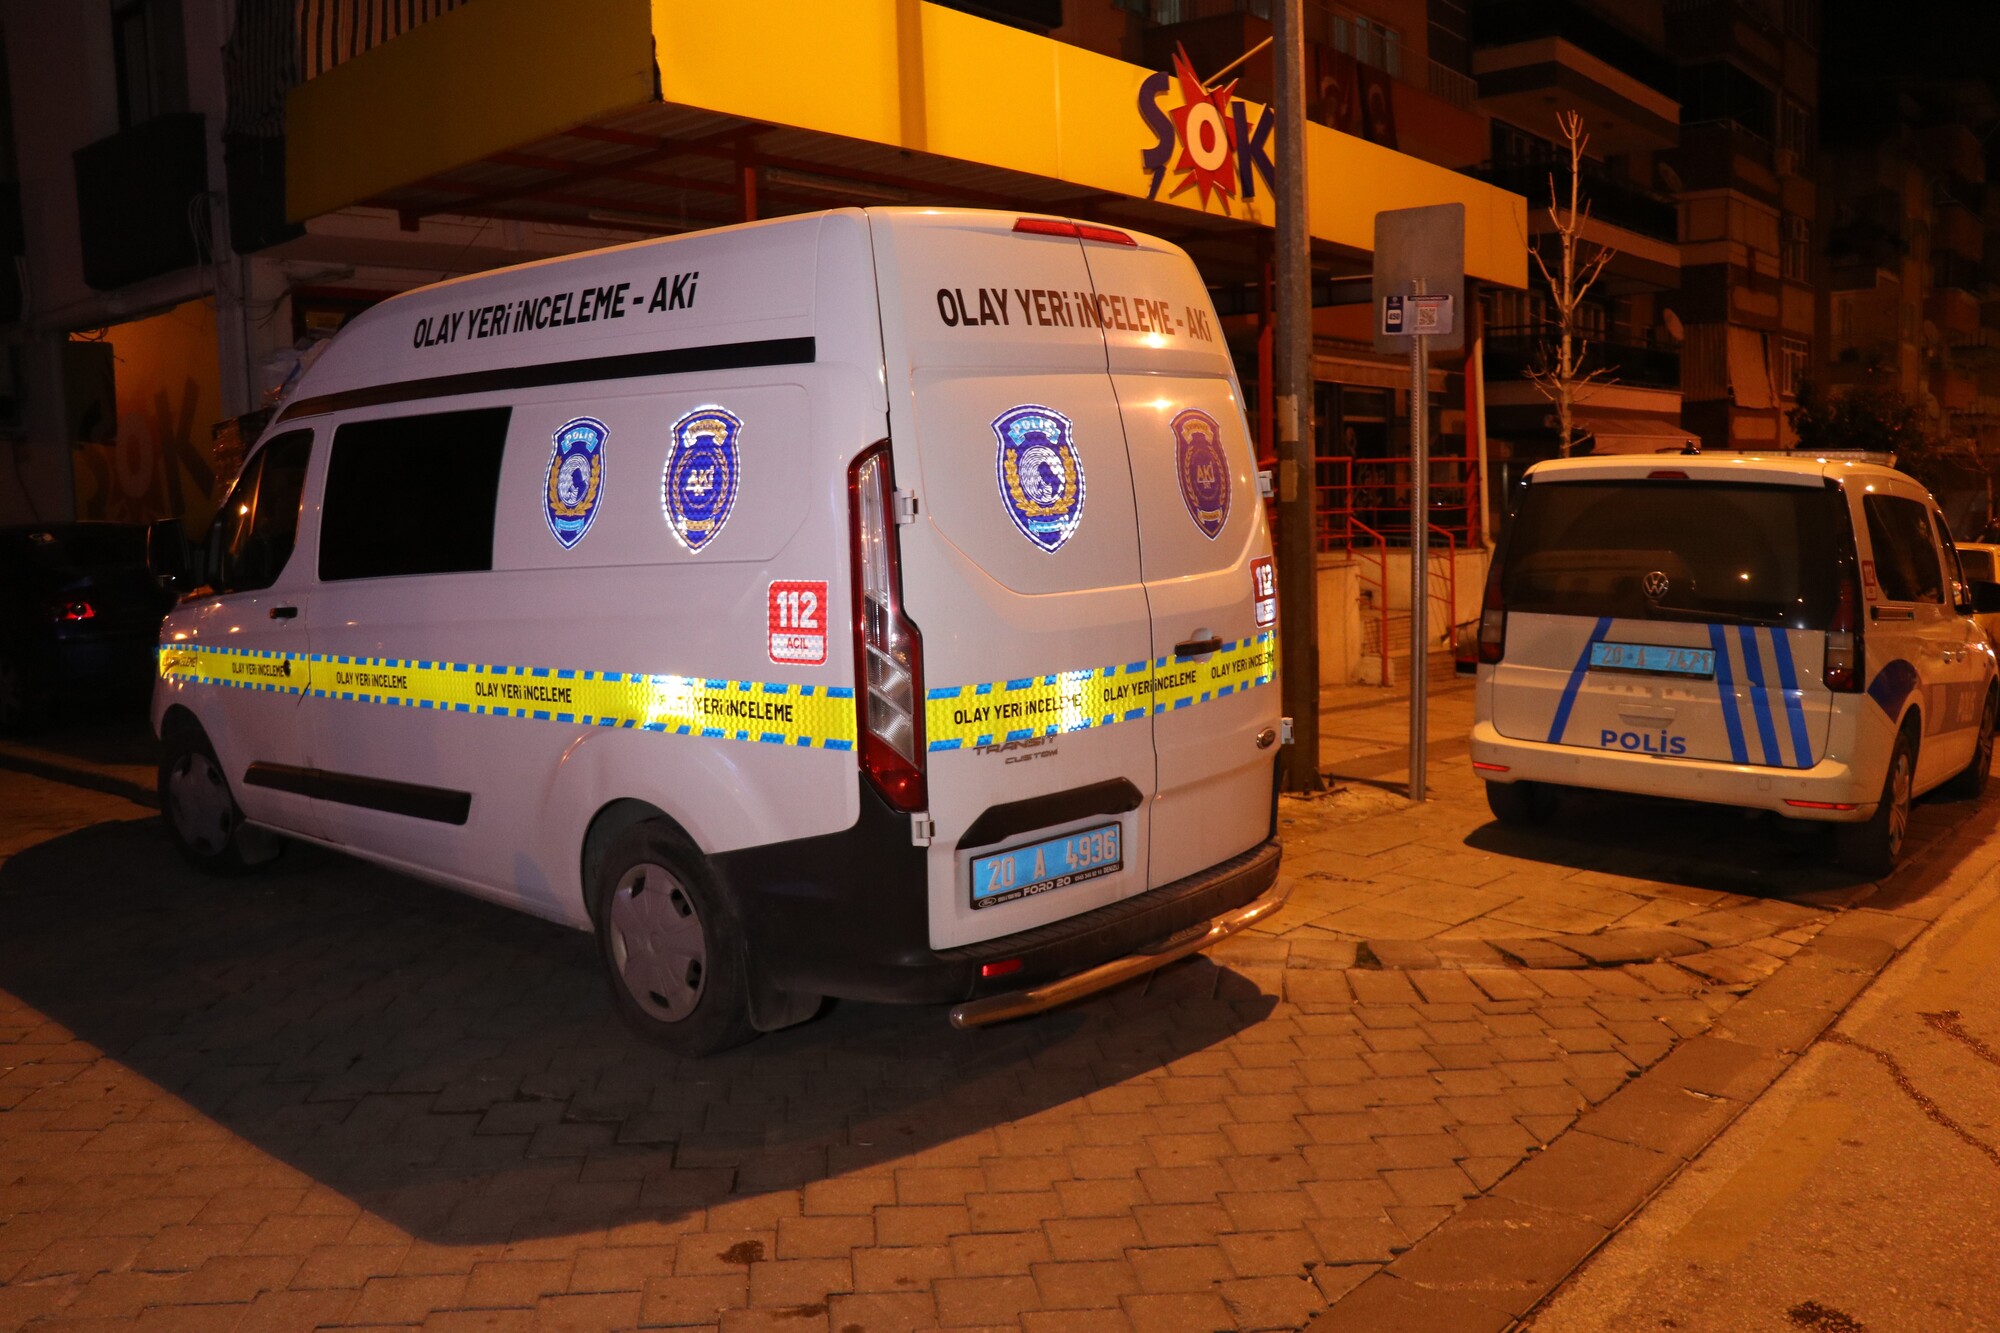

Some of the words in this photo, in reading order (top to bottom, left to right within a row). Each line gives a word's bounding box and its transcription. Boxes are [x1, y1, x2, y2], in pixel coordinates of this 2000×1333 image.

[1138, 71, 1274, 200] ŞOK
[937, 288, 1009, 327] OLAY
[413, 311, 464, 349] OLAY
[776, 591, 818, 629] 112
[1601, 644, 1623, 665] 20
[336, 671, 354, 685] OLAY
[1211, 662, 1230, 679] OLAY
[475, 682, 498, 697] OLAY
[1103, 684, 1129, 702] OLAY
[954, 706, 990, 725] OLAY
[972, 733, 1058, 755] TRANSIT
[1005, 748, 1058, 765] CUSTOM
[987, 856, 1016, 892] 20
[1034, 848, 1046, 880] A
[1066, 829, 1117, 870] 4936
[1023, 880, 1054, 897] FORD
[1056, 876, 1071, 888] 20
